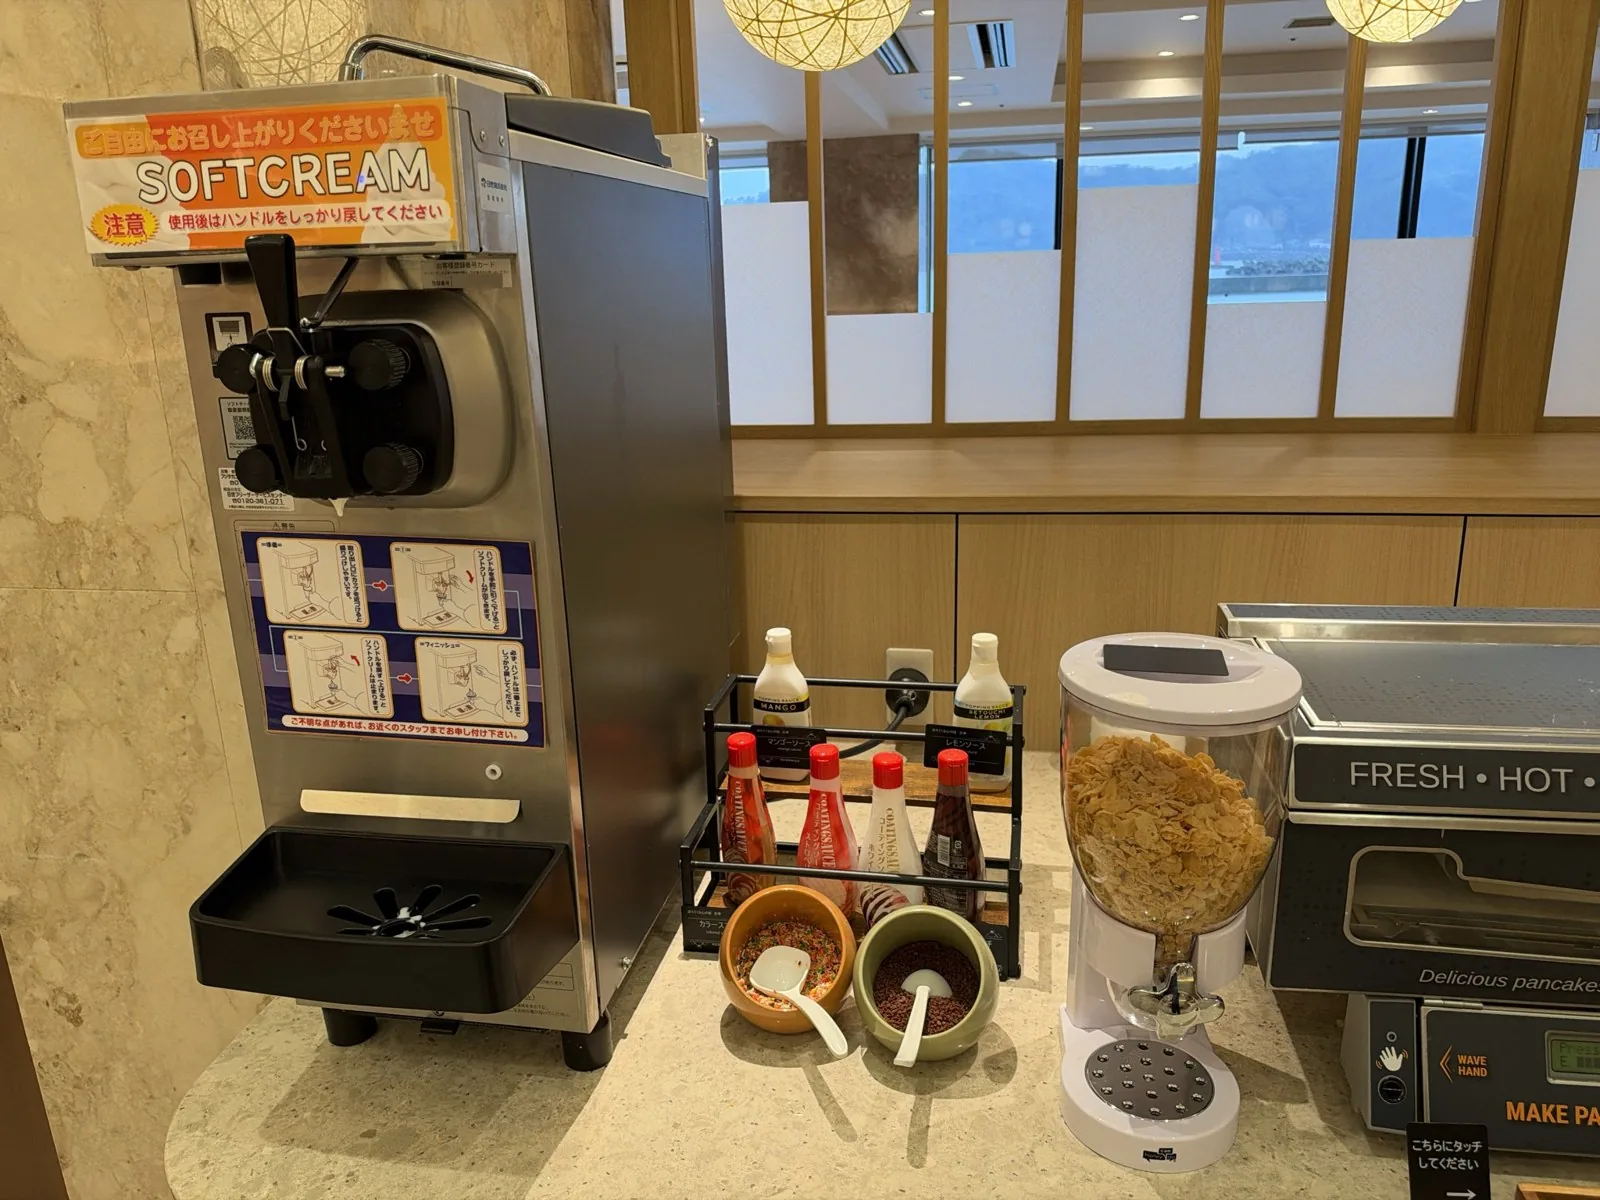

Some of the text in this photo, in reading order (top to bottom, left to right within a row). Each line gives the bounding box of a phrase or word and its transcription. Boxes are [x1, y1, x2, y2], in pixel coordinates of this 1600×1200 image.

[81, 110, 435, 156] ご自由にお召し上がりくださいませ
[137, 148, 430, 204] SOFTCREAM
[103, 212, 146, 238] 注意
[168, 204, 442, 231] 使用後はハンドルをしっかり戻してください
[761, 703, 797, 711] MANGO
[291, 717, 518, 740] ご不明な点があれば、お近くのスタッフまでお申し付け下さい。
[768, 738, 811, 748] マンゴーソース
[946, 739, 986, 750] レモンソース
[1350, 762, 1574, 793] FRESH HOT
[812, 803, 821, 867] コーティングソー
[876, 817, 886, 872] コーティングソ
[700, 920, 728, 929] カラース
[1419, 969, 1508, 988] Delicious
[1457, 1055, 1487, 1066] WAVE
[1458, 1066, 1487, 1077] HAND
[1506, 1101, 1569, 1125] MAKE
[1412, 1139, 1483, 1153] こちらにタッチ
[1418, 1157, 1479, 1170] してください
